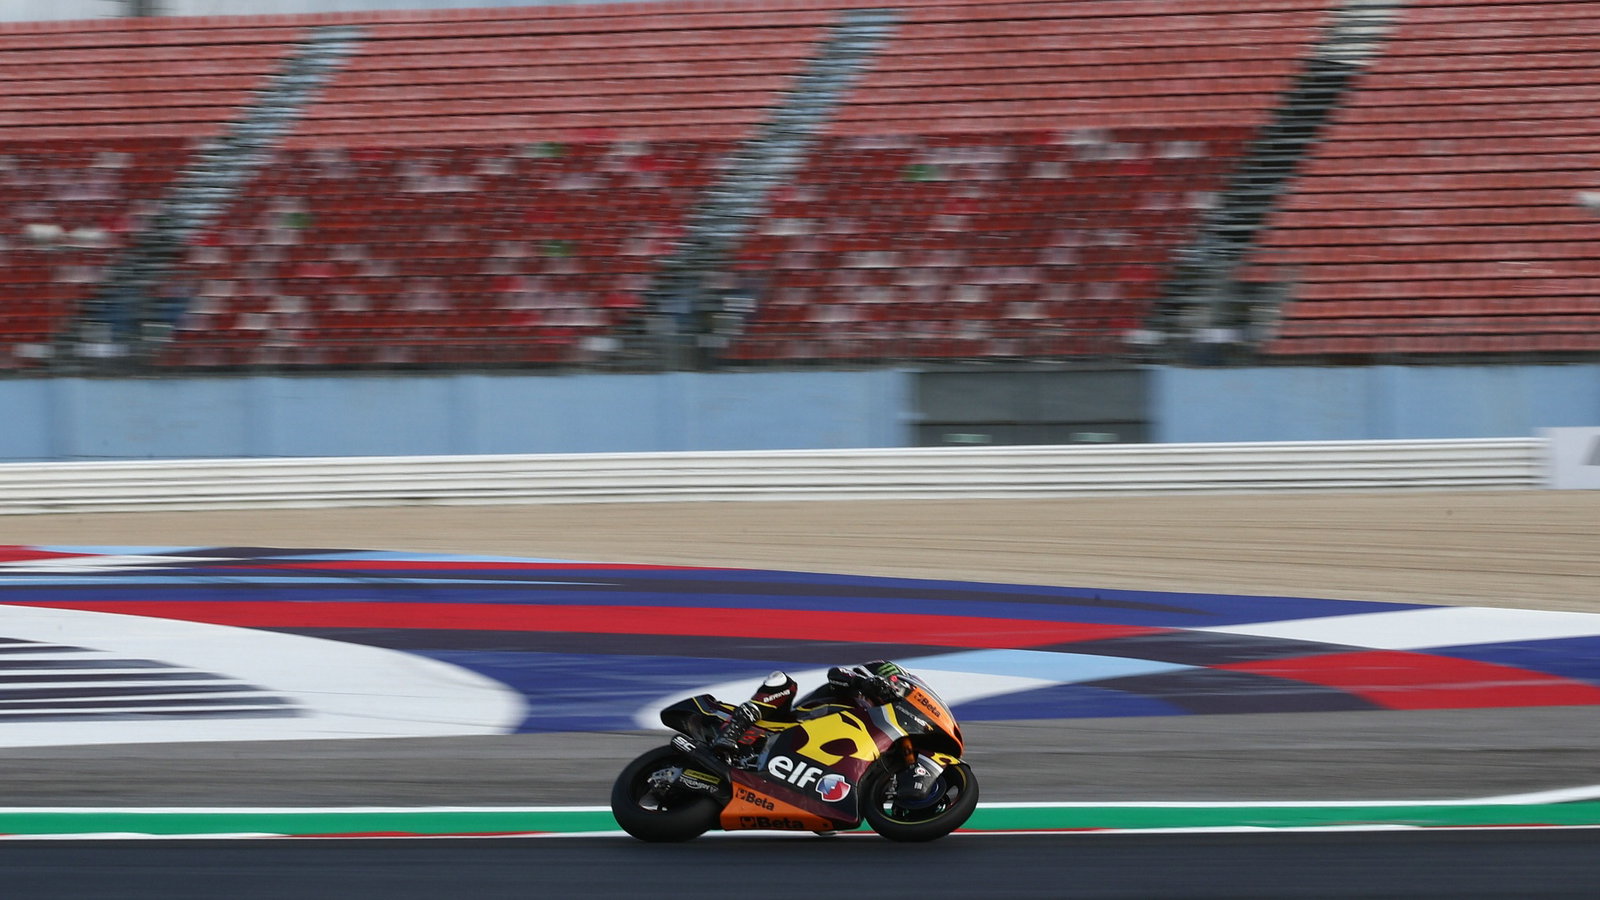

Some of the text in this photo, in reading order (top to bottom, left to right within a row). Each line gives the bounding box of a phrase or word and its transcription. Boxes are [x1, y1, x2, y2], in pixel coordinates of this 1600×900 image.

[920, 697, 941, 718] Beta
[768, 755, 823, 788] elf
[745, 791, 775, 811] Beta
[756, 816, 804, 829] Beta
